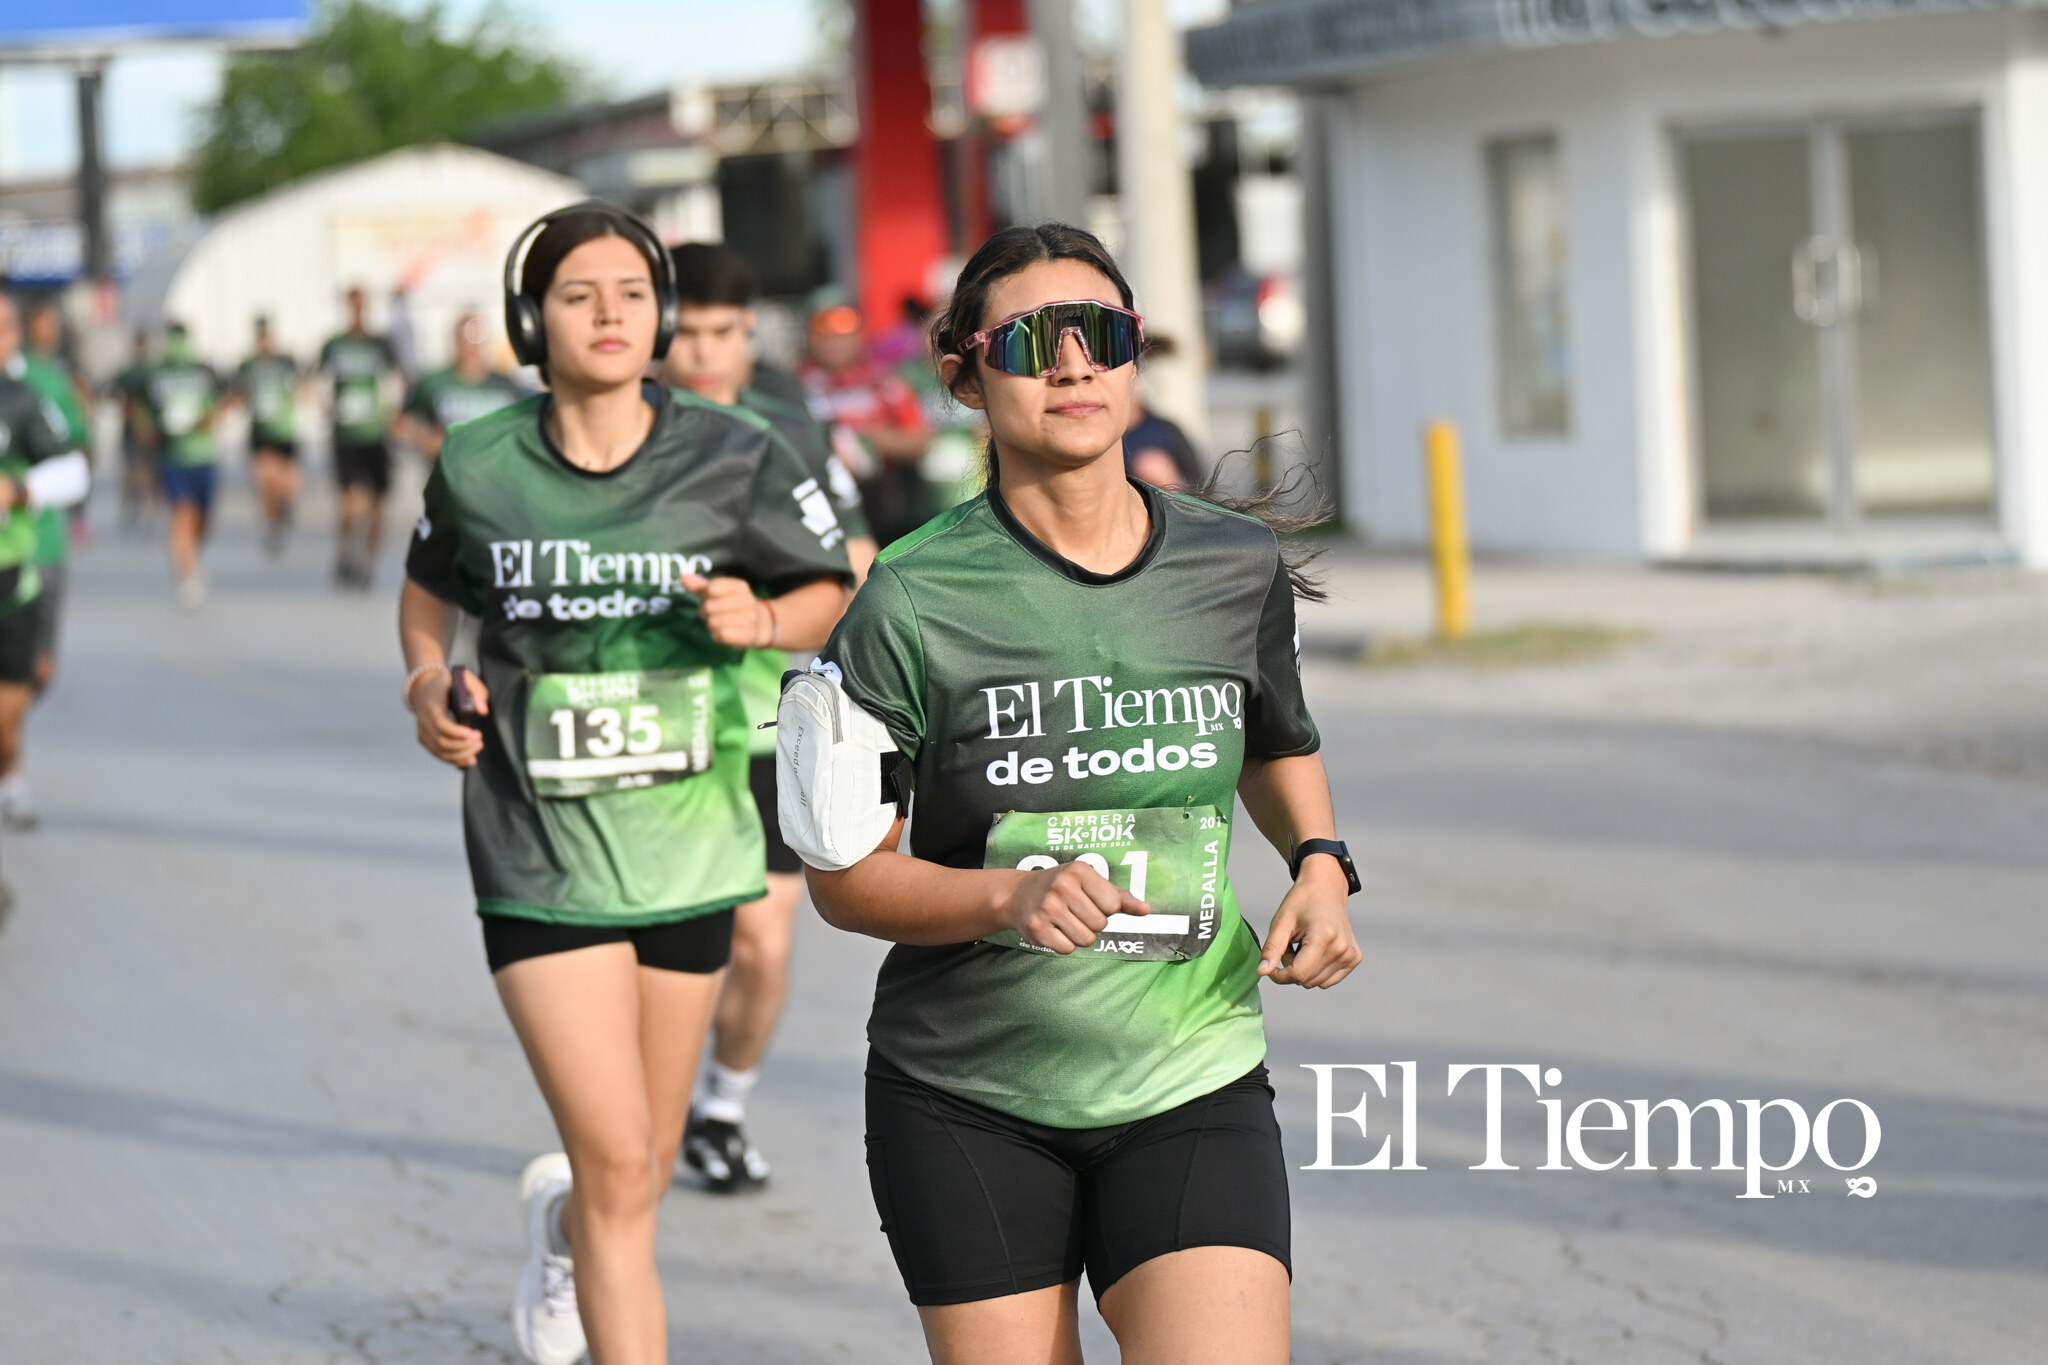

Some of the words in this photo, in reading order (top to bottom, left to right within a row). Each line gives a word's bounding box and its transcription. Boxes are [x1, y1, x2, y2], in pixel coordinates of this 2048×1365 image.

[489, 540, 534, 588] El
[979, 682, 1046, 739] El
[1054, 676, 1241, 736] Tiempo
[1210, 722, 1224, 732] MX
[550, 705, 662, 760] 135
[793, 725, 804, 766] Exceed
[986, 751, 1053, 786] de
[1063, 739, 1217, 779] todos
[1047, 814, 1136, 827] CARRERA
[1198, 840, 1219, 940] MEDALLA
